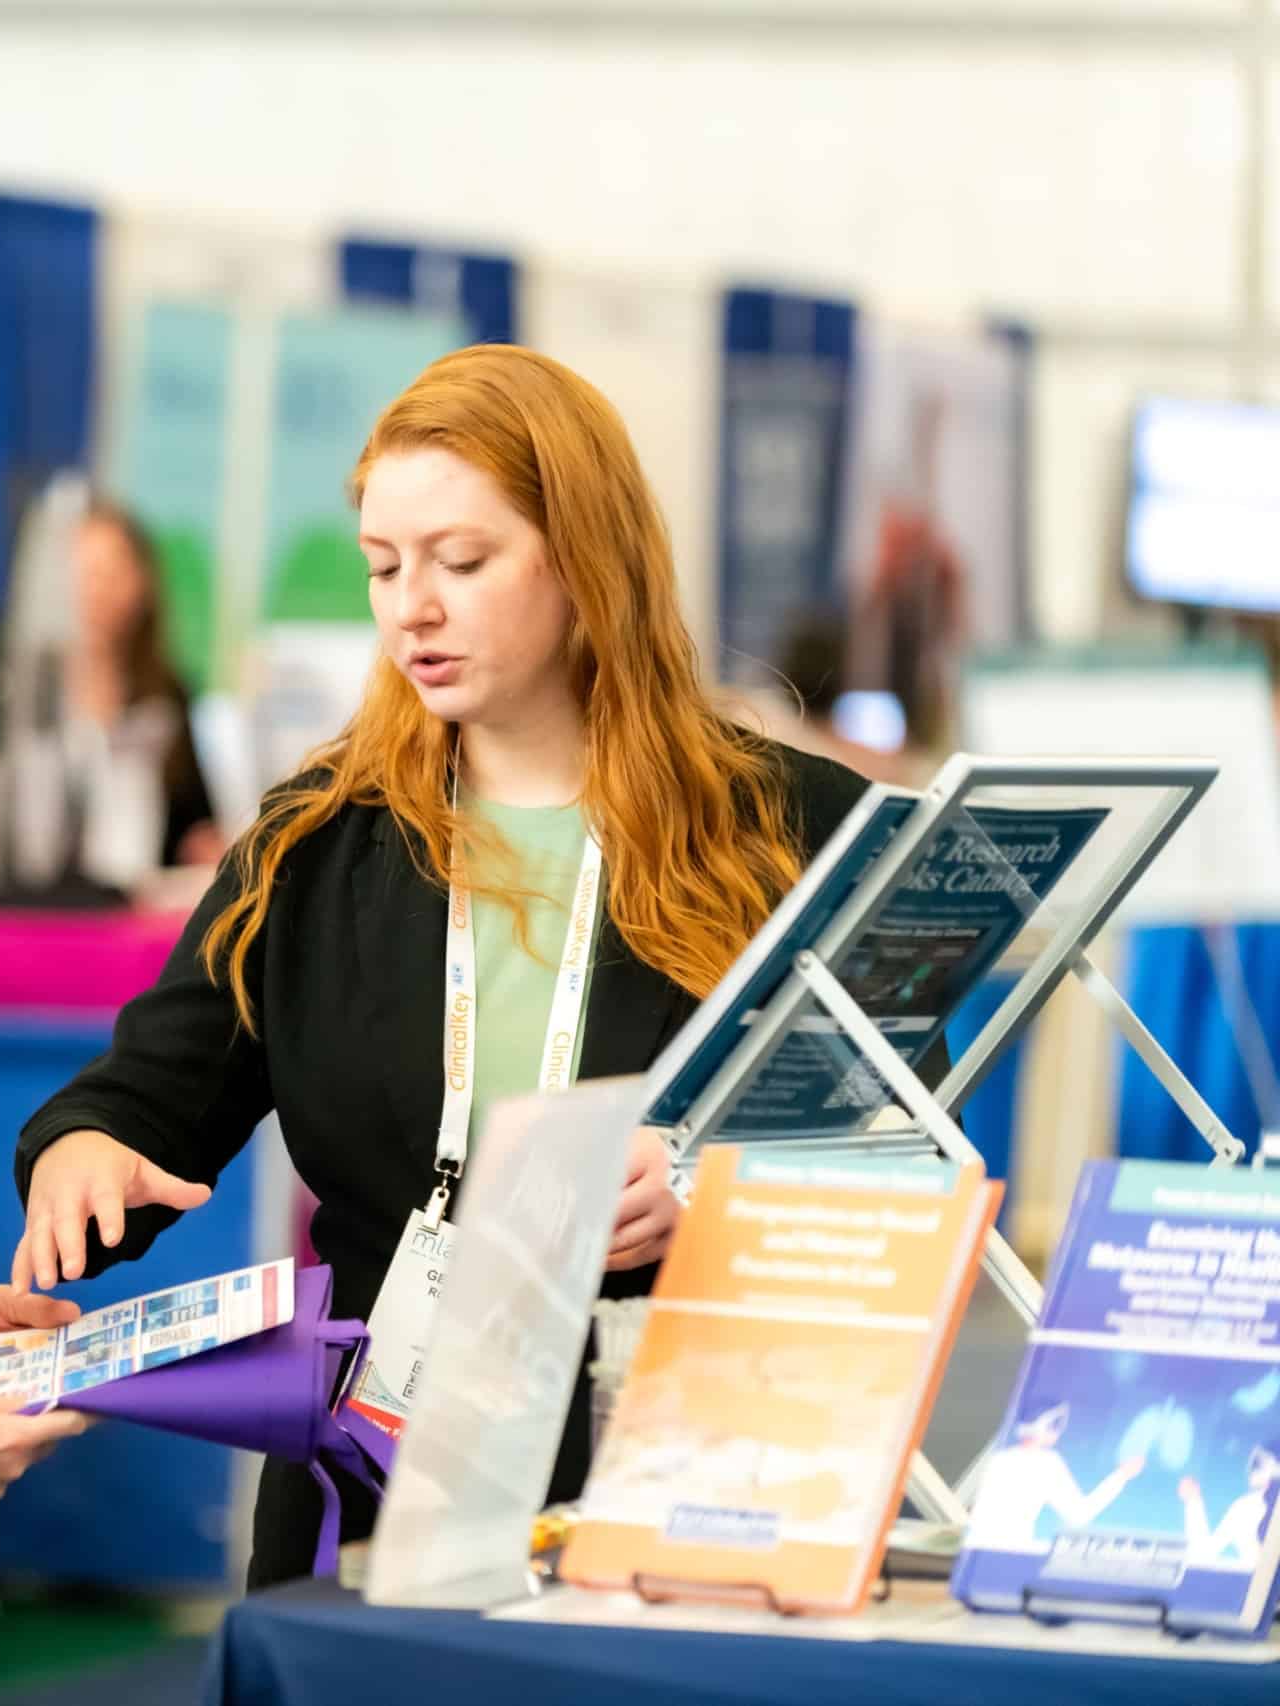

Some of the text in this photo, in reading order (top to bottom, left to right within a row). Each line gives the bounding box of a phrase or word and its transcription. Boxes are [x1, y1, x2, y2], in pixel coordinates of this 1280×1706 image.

[942, 835, 1062, 865] Research
[945, 865, 1040, 900] Catalog
[447, 991, 472, 1092] ClinicalKey
